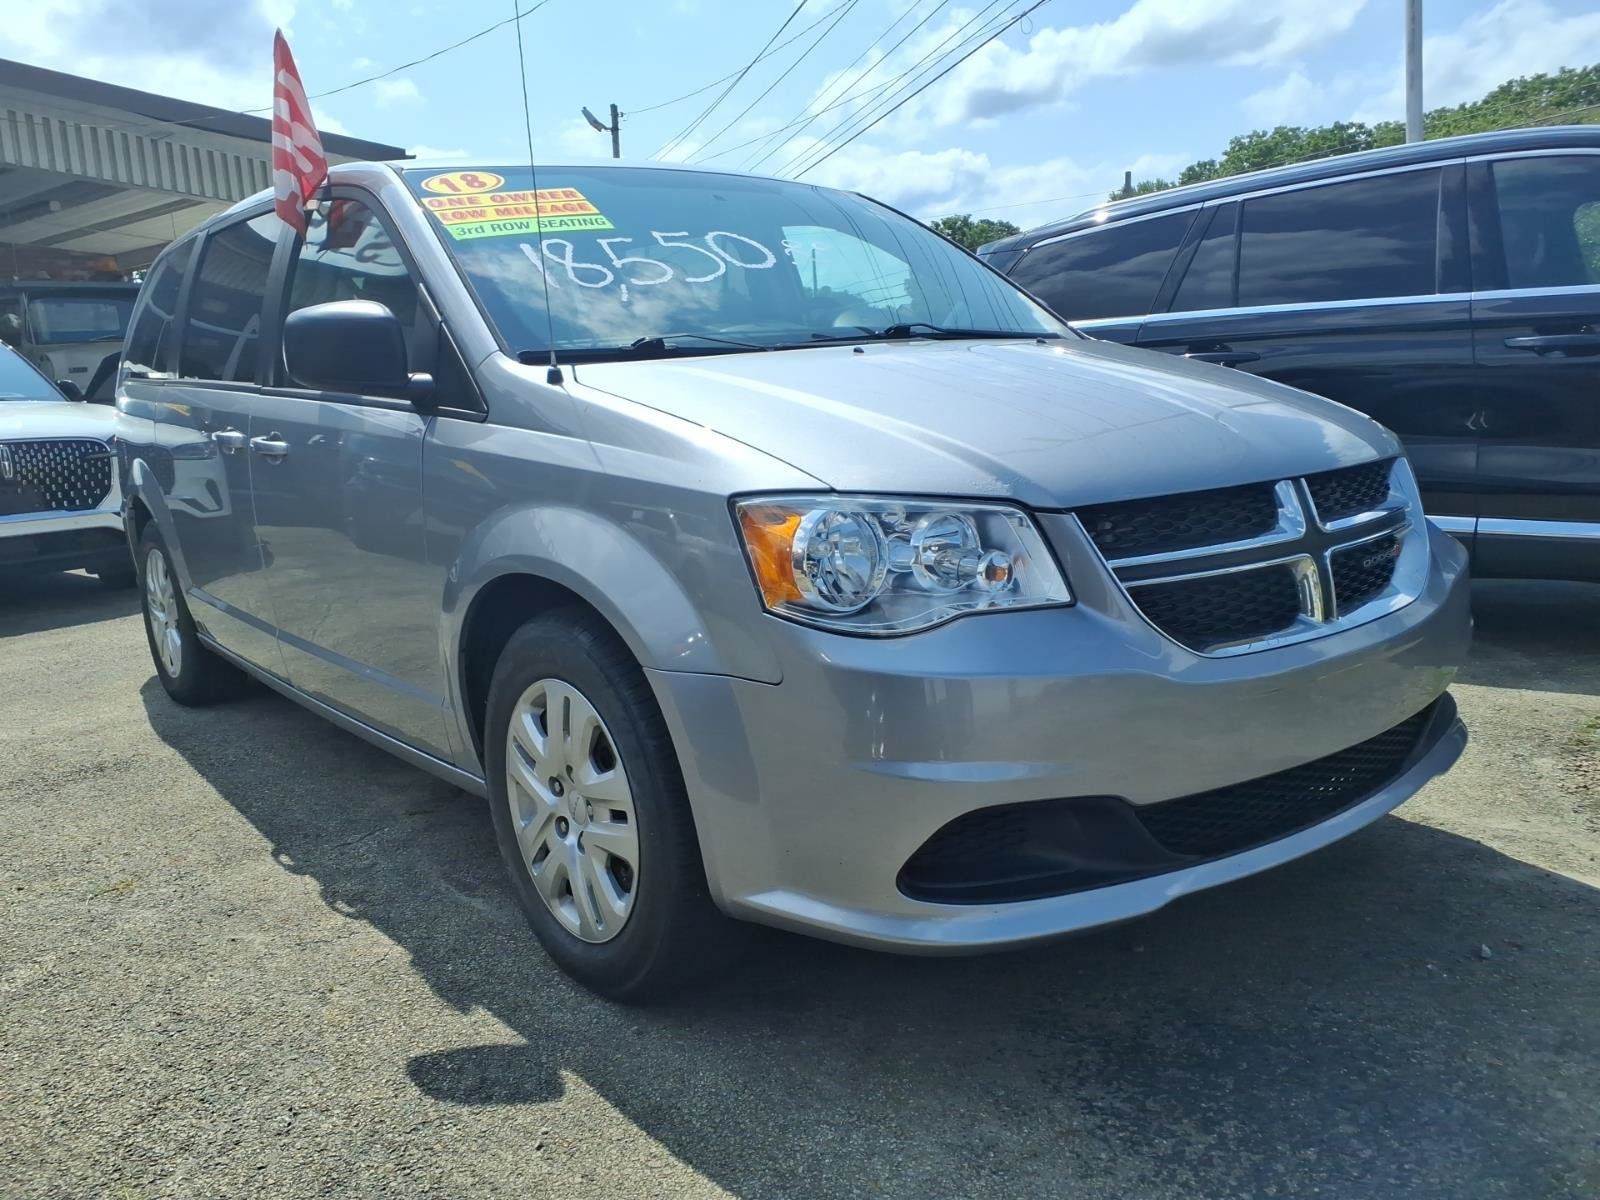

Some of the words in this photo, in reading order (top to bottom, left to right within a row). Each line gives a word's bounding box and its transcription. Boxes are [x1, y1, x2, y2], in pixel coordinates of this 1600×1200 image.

[439, 174, 487, 192] 18
[428, 196, 482, 208] ONE
[489, 190, 578, 203] OWNER
[440, 209, 486, 221] LOW
[494, 203, 592, 216] MILEAGE
[456, 225, 485, 236] 3rd
[490, 222, 530, 232] ROW
[538, 217, 606, 229] SEATING
